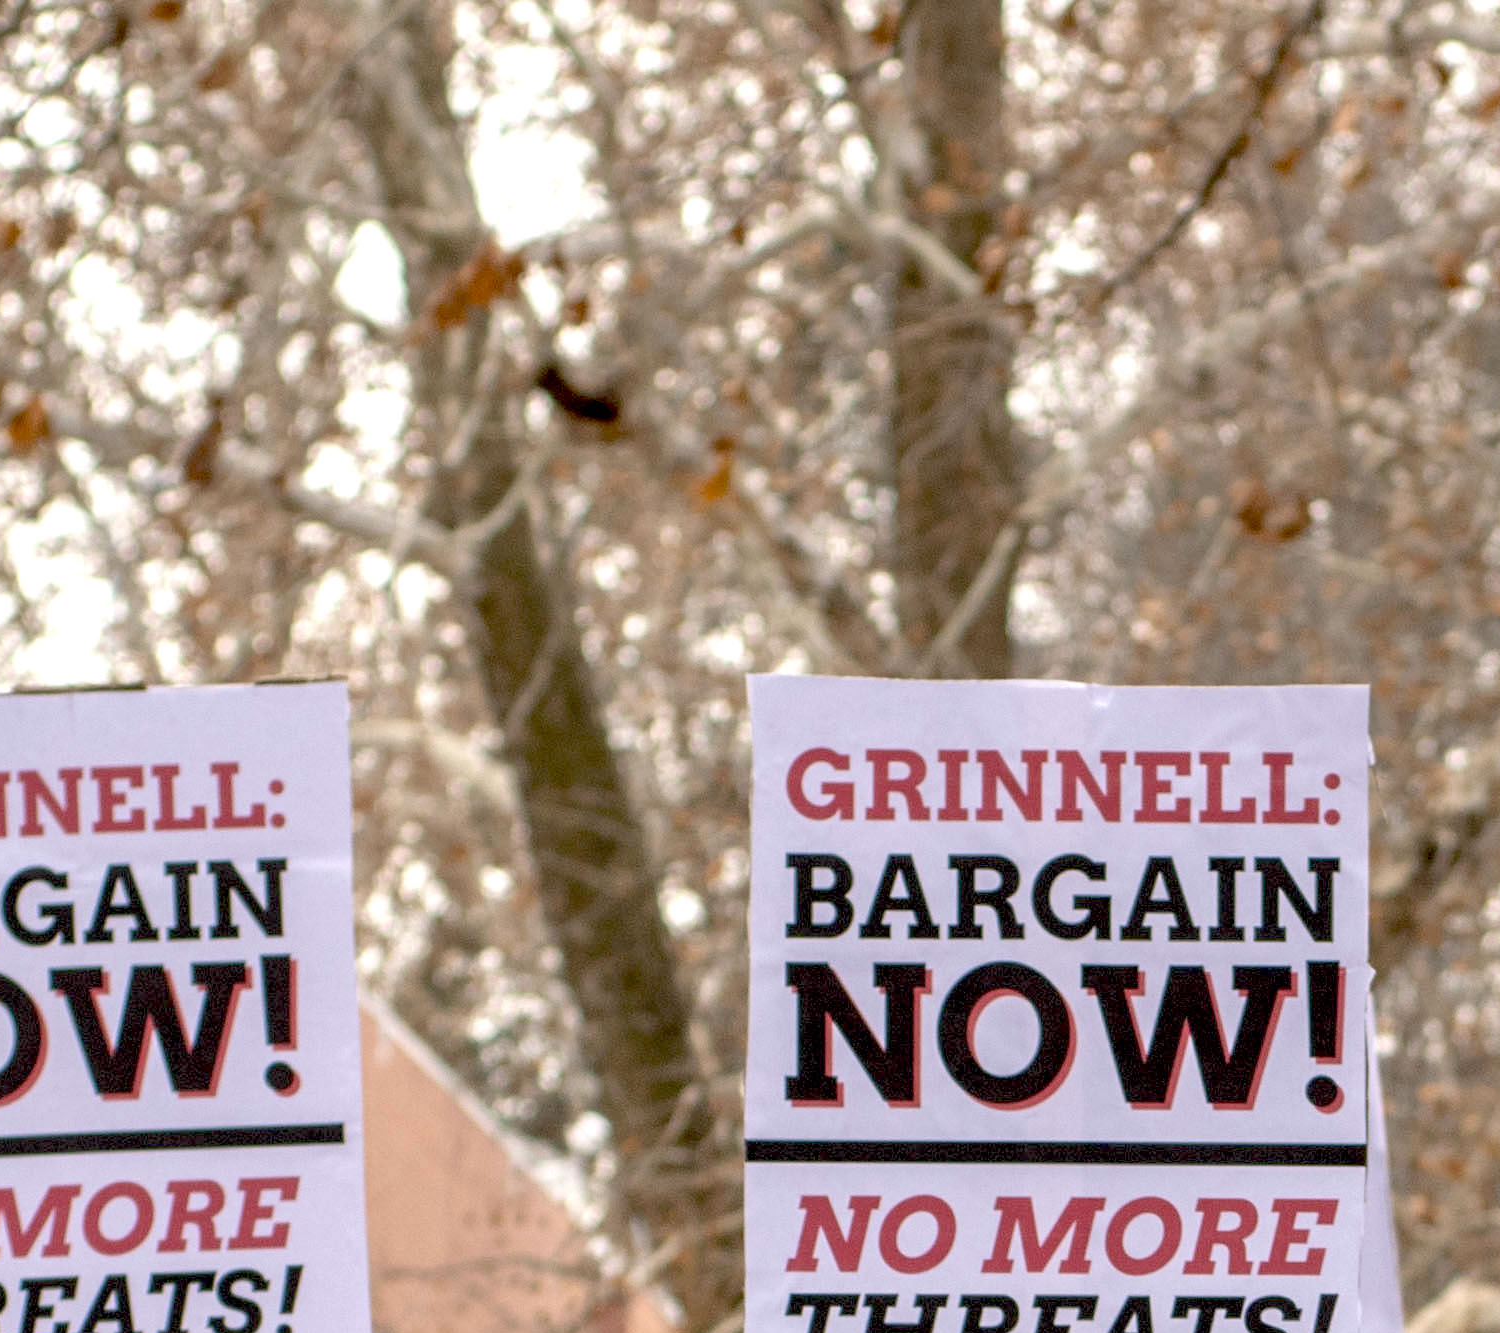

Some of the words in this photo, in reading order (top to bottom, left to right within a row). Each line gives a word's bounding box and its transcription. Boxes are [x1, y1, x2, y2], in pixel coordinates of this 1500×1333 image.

[785, 747, 1341, 826] GRINNELL:
[784, 853, 1341, 942] BARGAIN
[784, 959, 1346, 1114] NOW!
[785, 1193, 958, 1274] NO
[981, 1196, 1339, 1277] MORE
